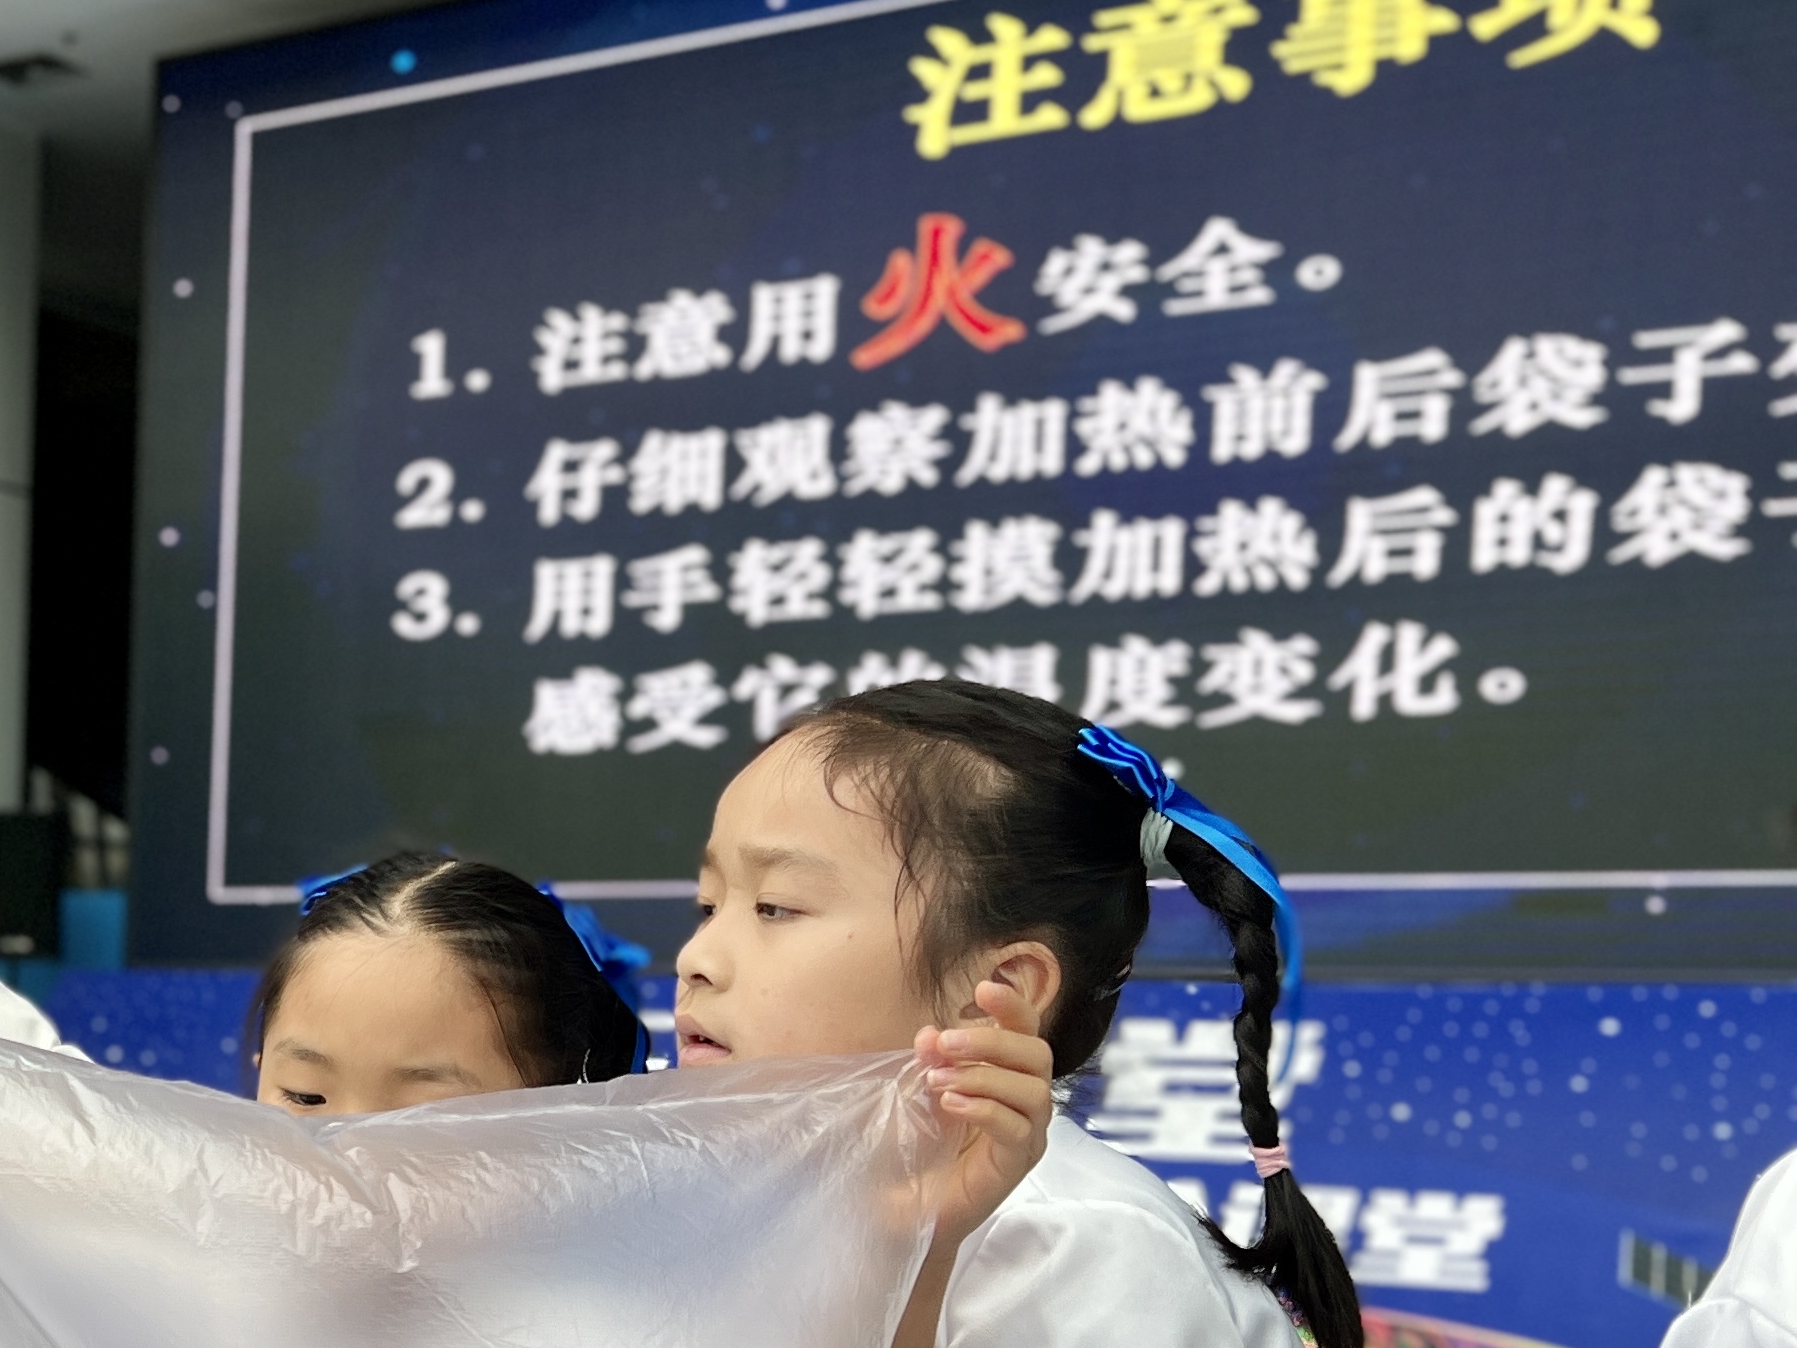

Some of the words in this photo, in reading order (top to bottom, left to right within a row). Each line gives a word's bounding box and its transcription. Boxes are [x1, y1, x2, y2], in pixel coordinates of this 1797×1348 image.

[408, 328, 491, 399] 1.
[530, 213, 1342, 395] 注意用火安全。
[394, 458, 486, 529] 2.
[524, 318, 1797, 528] 仔细观察加热前后袋子
[390, 570, 481, 641] 3.
[522, 460, 1797, 644] 用手轻轻摸加热后的袋
